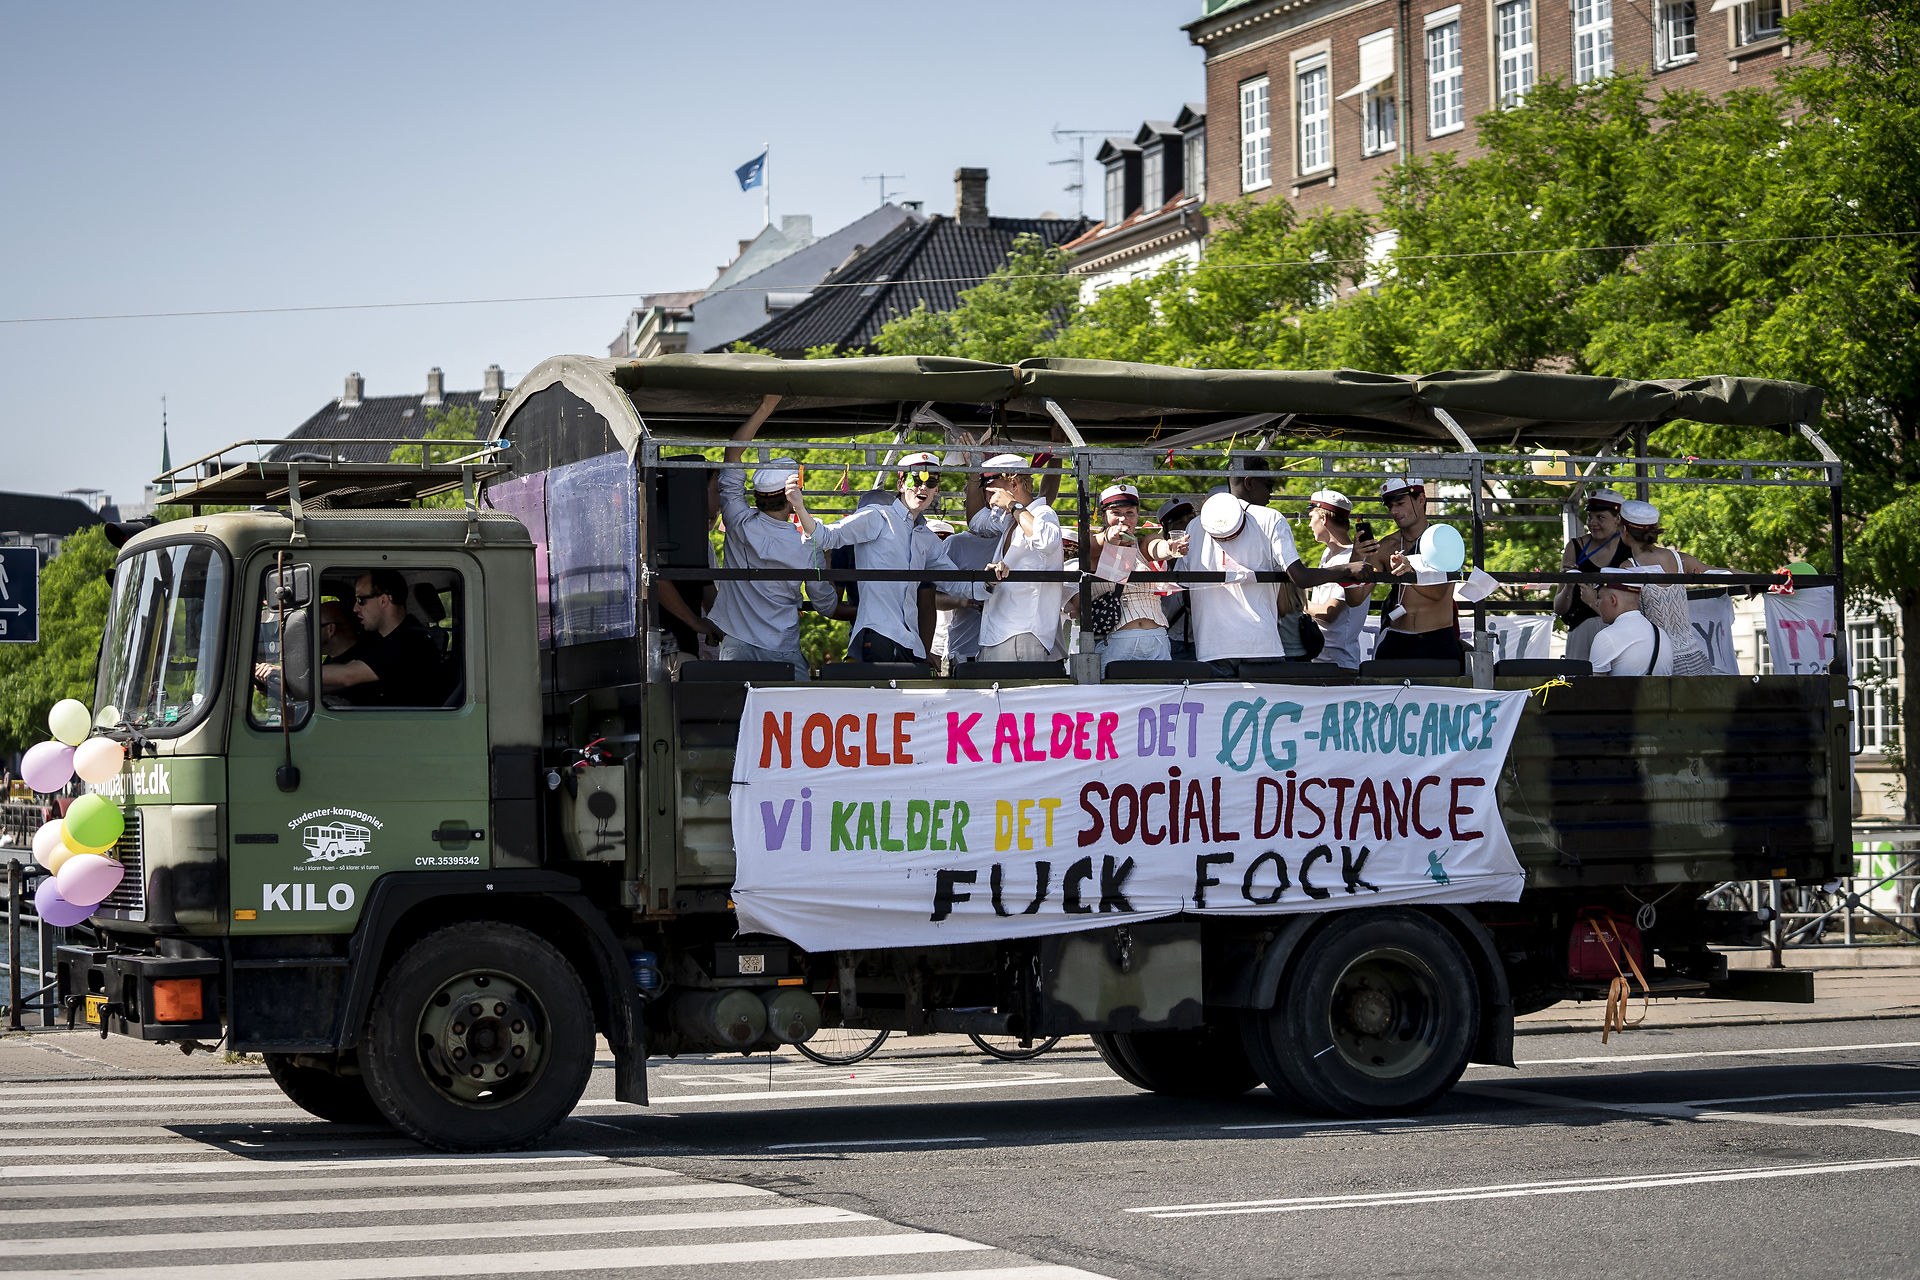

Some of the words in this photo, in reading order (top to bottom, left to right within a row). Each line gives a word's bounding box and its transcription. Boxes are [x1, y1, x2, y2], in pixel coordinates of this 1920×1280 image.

[758, 711, 916, 769] NOGLE
[946, 711, 1120, 764] KALDER
[1137, 702, 1204, 758] DET
[287, 806, 384, 830] Studenter-kompagniet
[830, 799, 970, 852] KALDER
[995, 798, 1061, 851] DET
[414, 856, 480, 866] CVR.35395342
[262, 883, 355, 911] KILO
[486, 883, 494, 891] 98
[930, 855, 1136, 922] FUCK
[1193, 844, 1381, 909] FOCK
